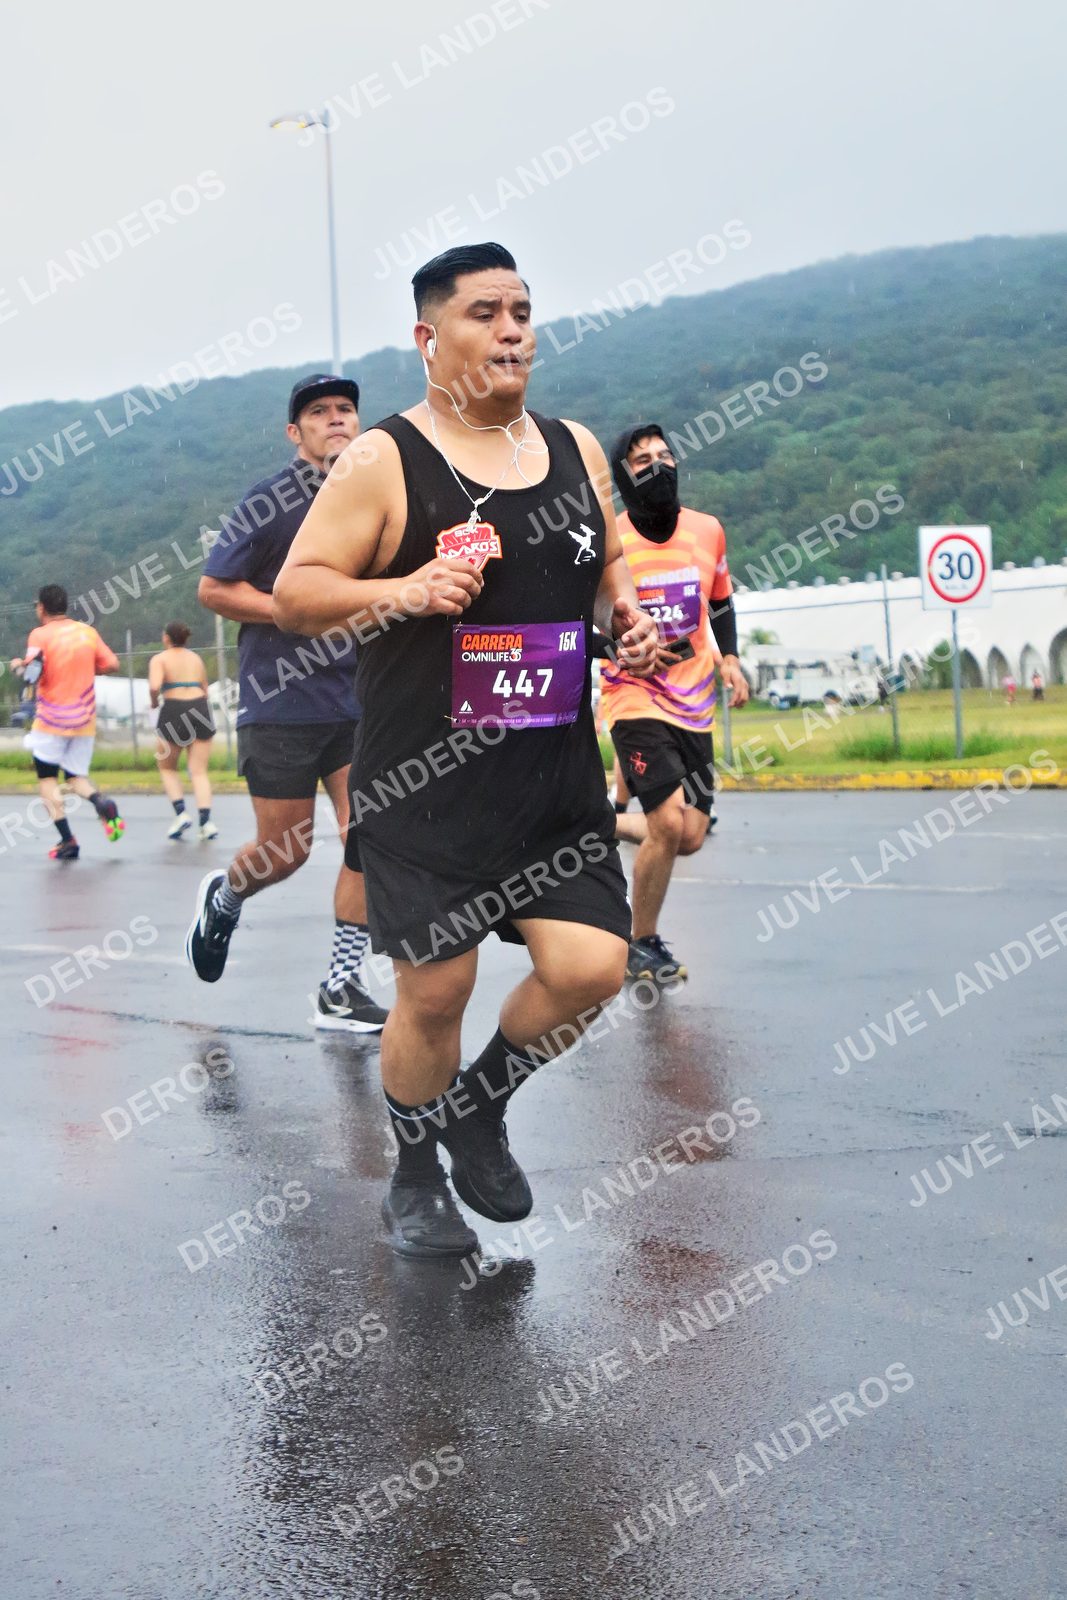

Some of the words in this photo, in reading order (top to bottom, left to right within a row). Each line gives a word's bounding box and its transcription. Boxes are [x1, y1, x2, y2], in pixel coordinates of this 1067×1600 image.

[938, 552, 974, 580] 30
[461, 633, 523, 651] CARRERA
[558, 630, 578, 651] 15K
[492, 668, 553, 698] 447
